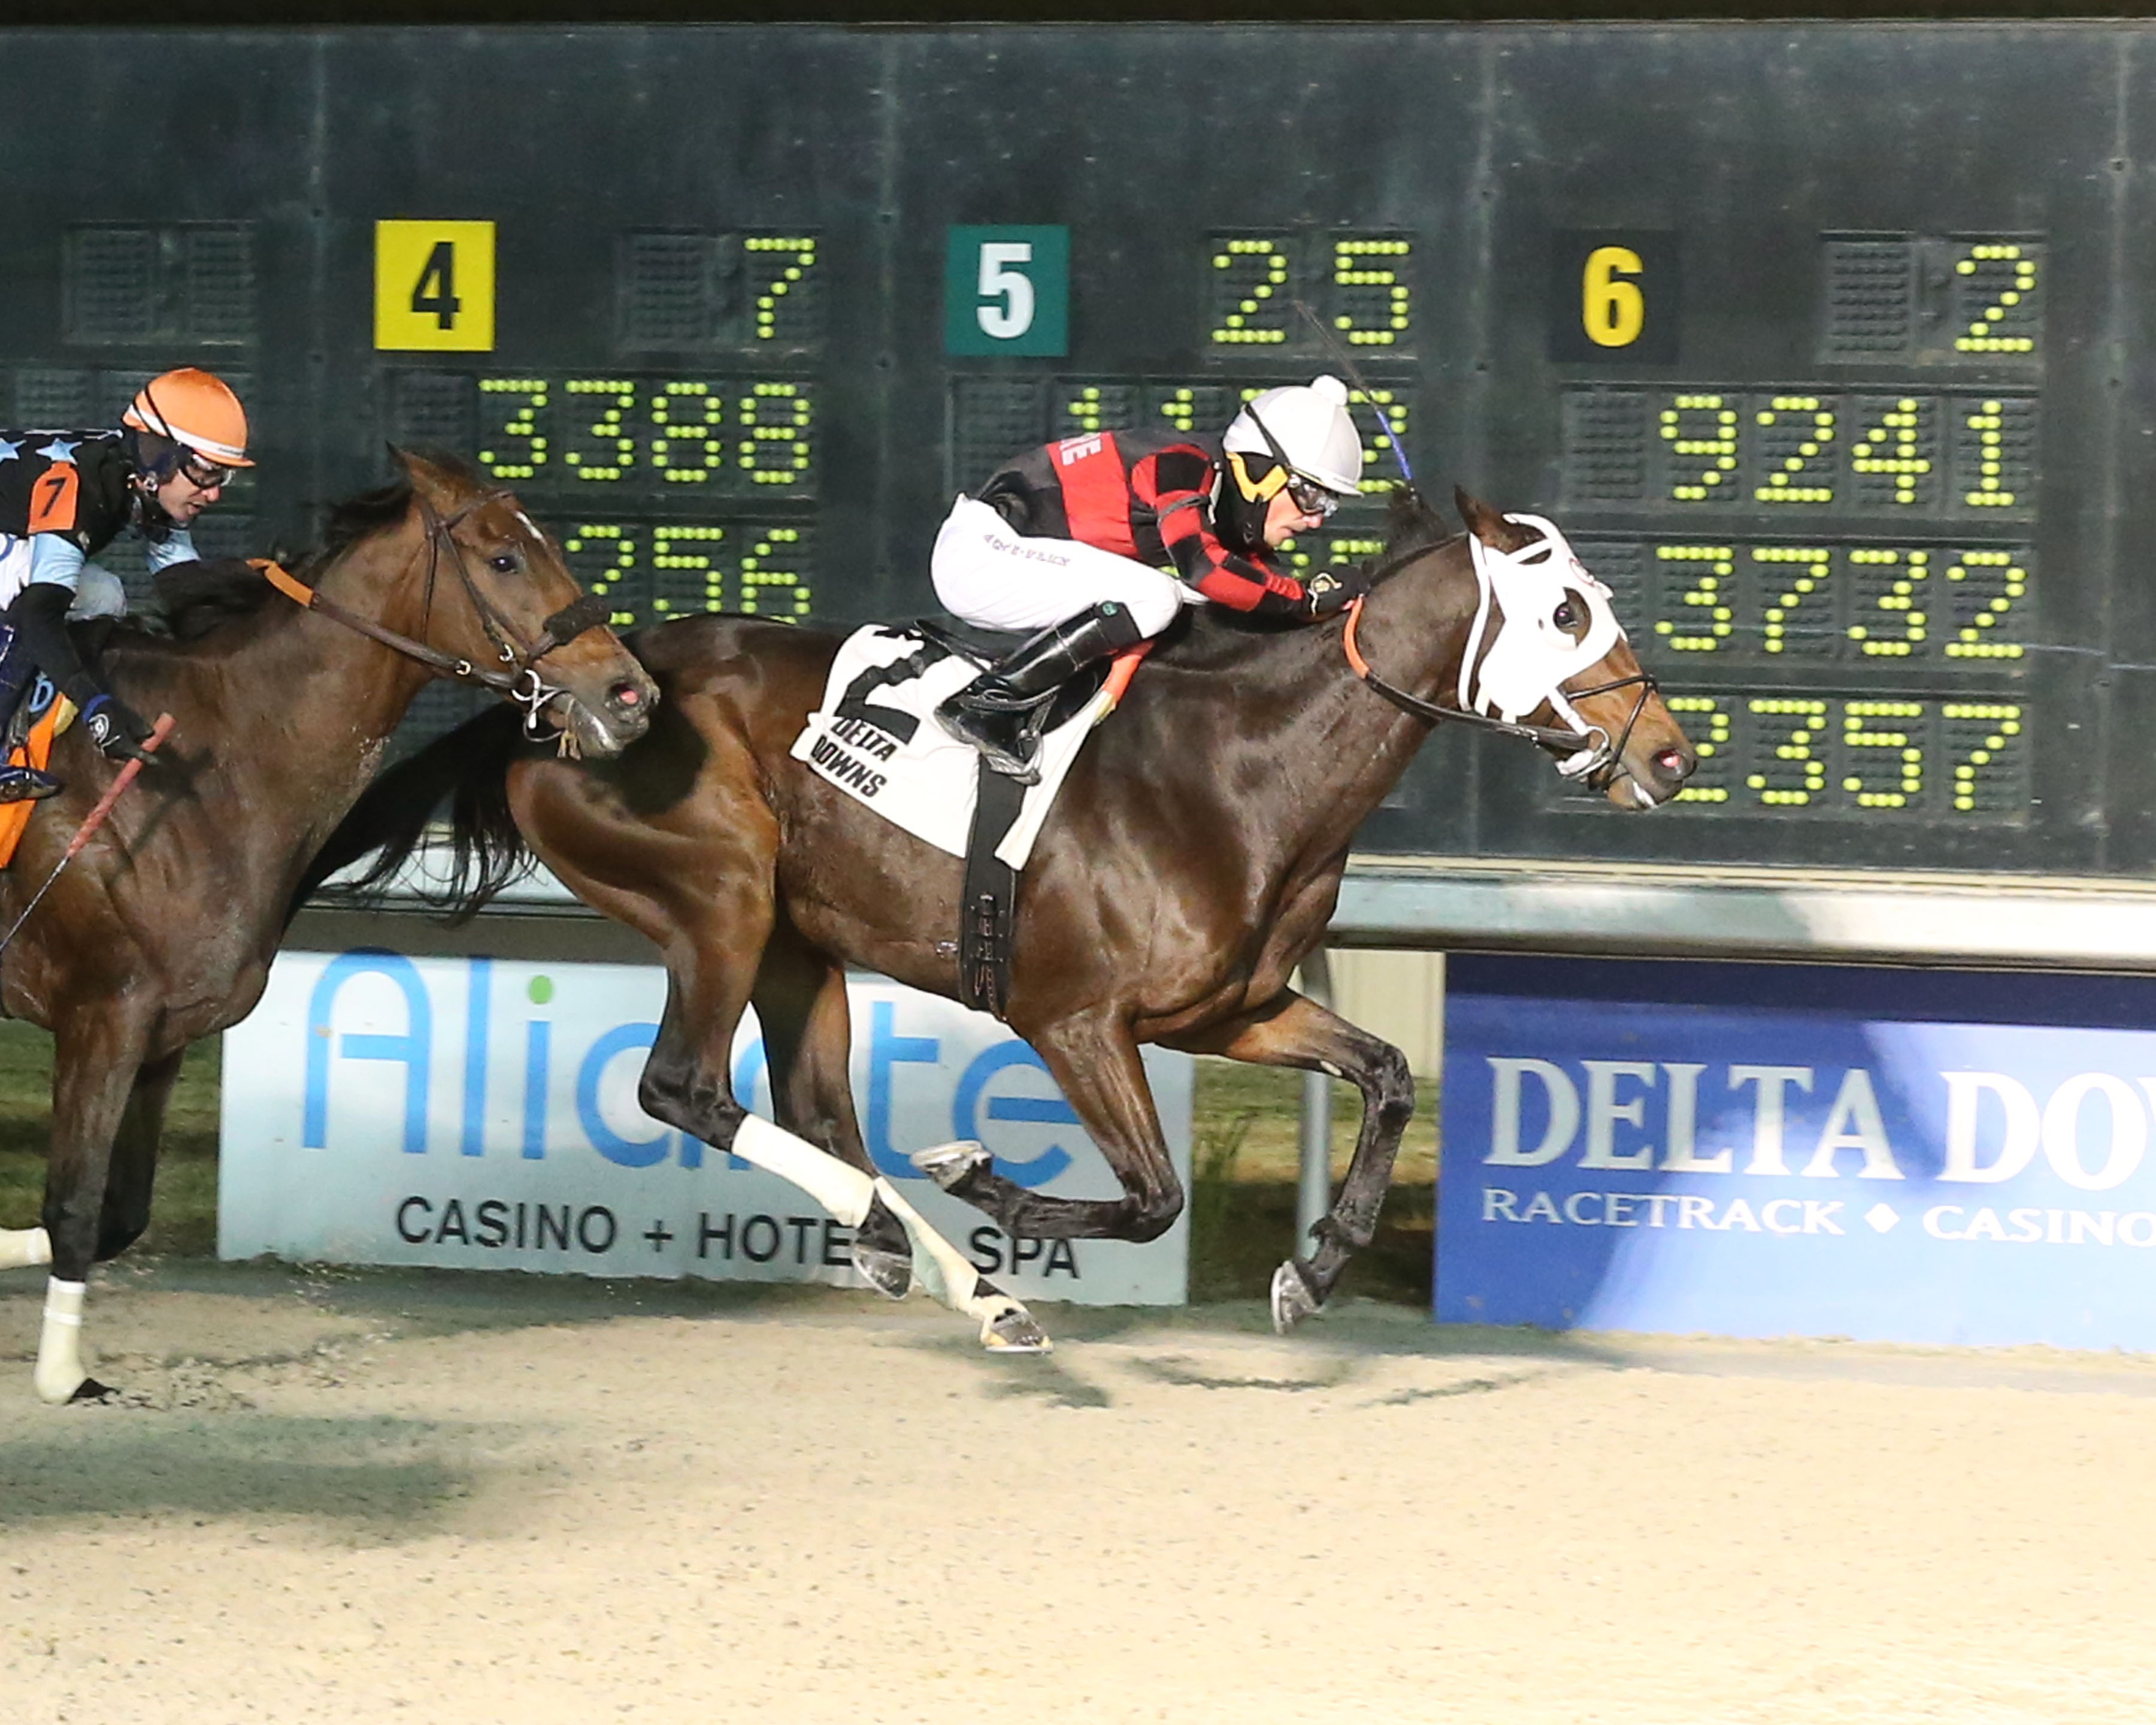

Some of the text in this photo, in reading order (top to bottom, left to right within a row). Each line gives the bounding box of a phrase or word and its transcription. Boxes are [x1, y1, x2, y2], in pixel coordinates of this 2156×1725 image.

[411, 241, 461, 330] 4
[745, 238, 815, 338] 7
[977, 243, 1035, 339] 5
[1212, 240, 1410, 344] 25
[1582, 246, 1645, 347] 6
[1954, 246, 2036, 352] 2
[479, 379, 810, 484] 3388
[1660, 395, 2015, 506] 9241
[41, 477, 66, 518] 7
[1655, 546, 2025, 658] 3732
[810, 734, 888, 798] DOWNS
[830, 718, 898, 762] DELTA
[1666, 697, 2021, 810] 2357
[1482, 1056, 2156, 1191] DELTA DO
[397, 1196, 617, 1254] CASINO
[697, 1212, 853, 1266] HOTE
[970, 1224, 1080, 1279] SPA
[1482, 1188, 2156, 1248] RACETRACK CASINO
